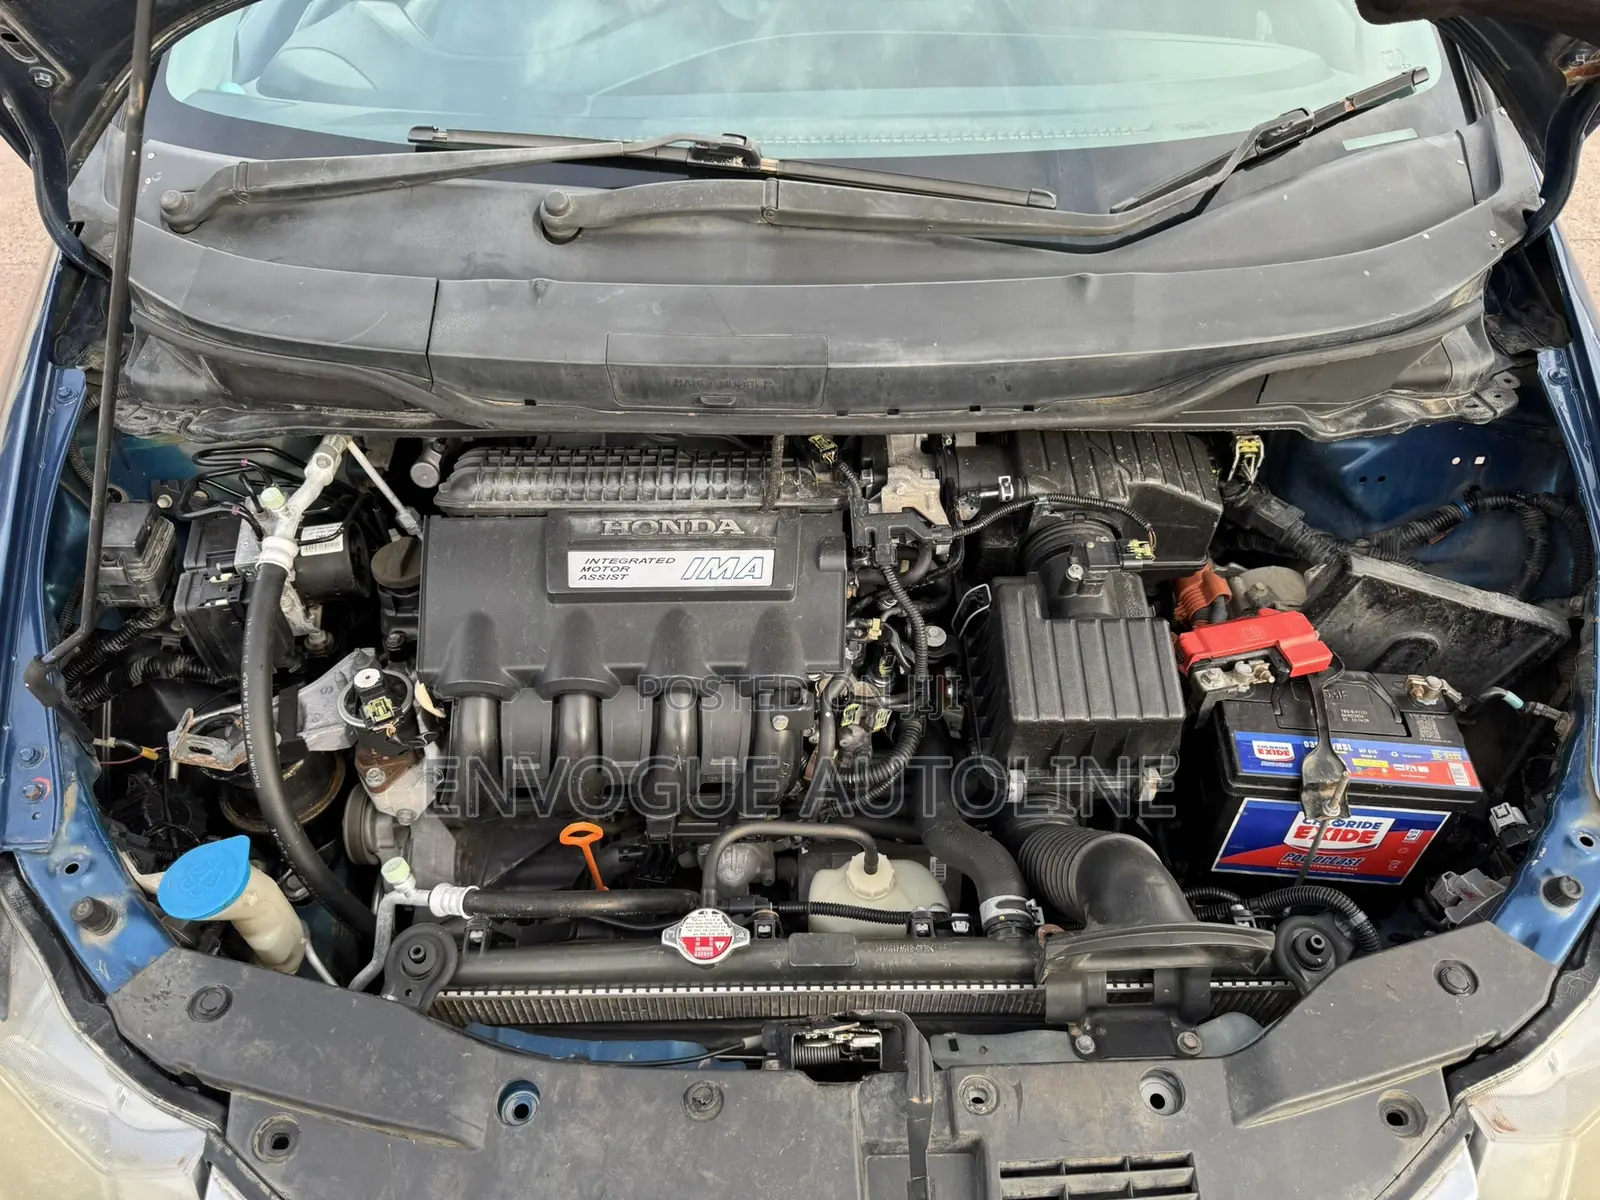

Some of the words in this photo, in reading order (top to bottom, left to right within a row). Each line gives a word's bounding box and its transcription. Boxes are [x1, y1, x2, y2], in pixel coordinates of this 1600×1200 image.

[600, 518, 746, 537] HONDA
[583, 557, 676, 565] INTEGRATED
[580, 565, 631, 573] MOTOR
[680, 556, 765, 580] IMA
[578, 573, 630, 581] ASSIST
[1256, 748, 1291, 757] EXIDE
[248, 753, 262, 789] NICHIRIN
[1302, 817, 1385, 830] CHORIDE
[1292, 825, 1380, 844] EXIDE
